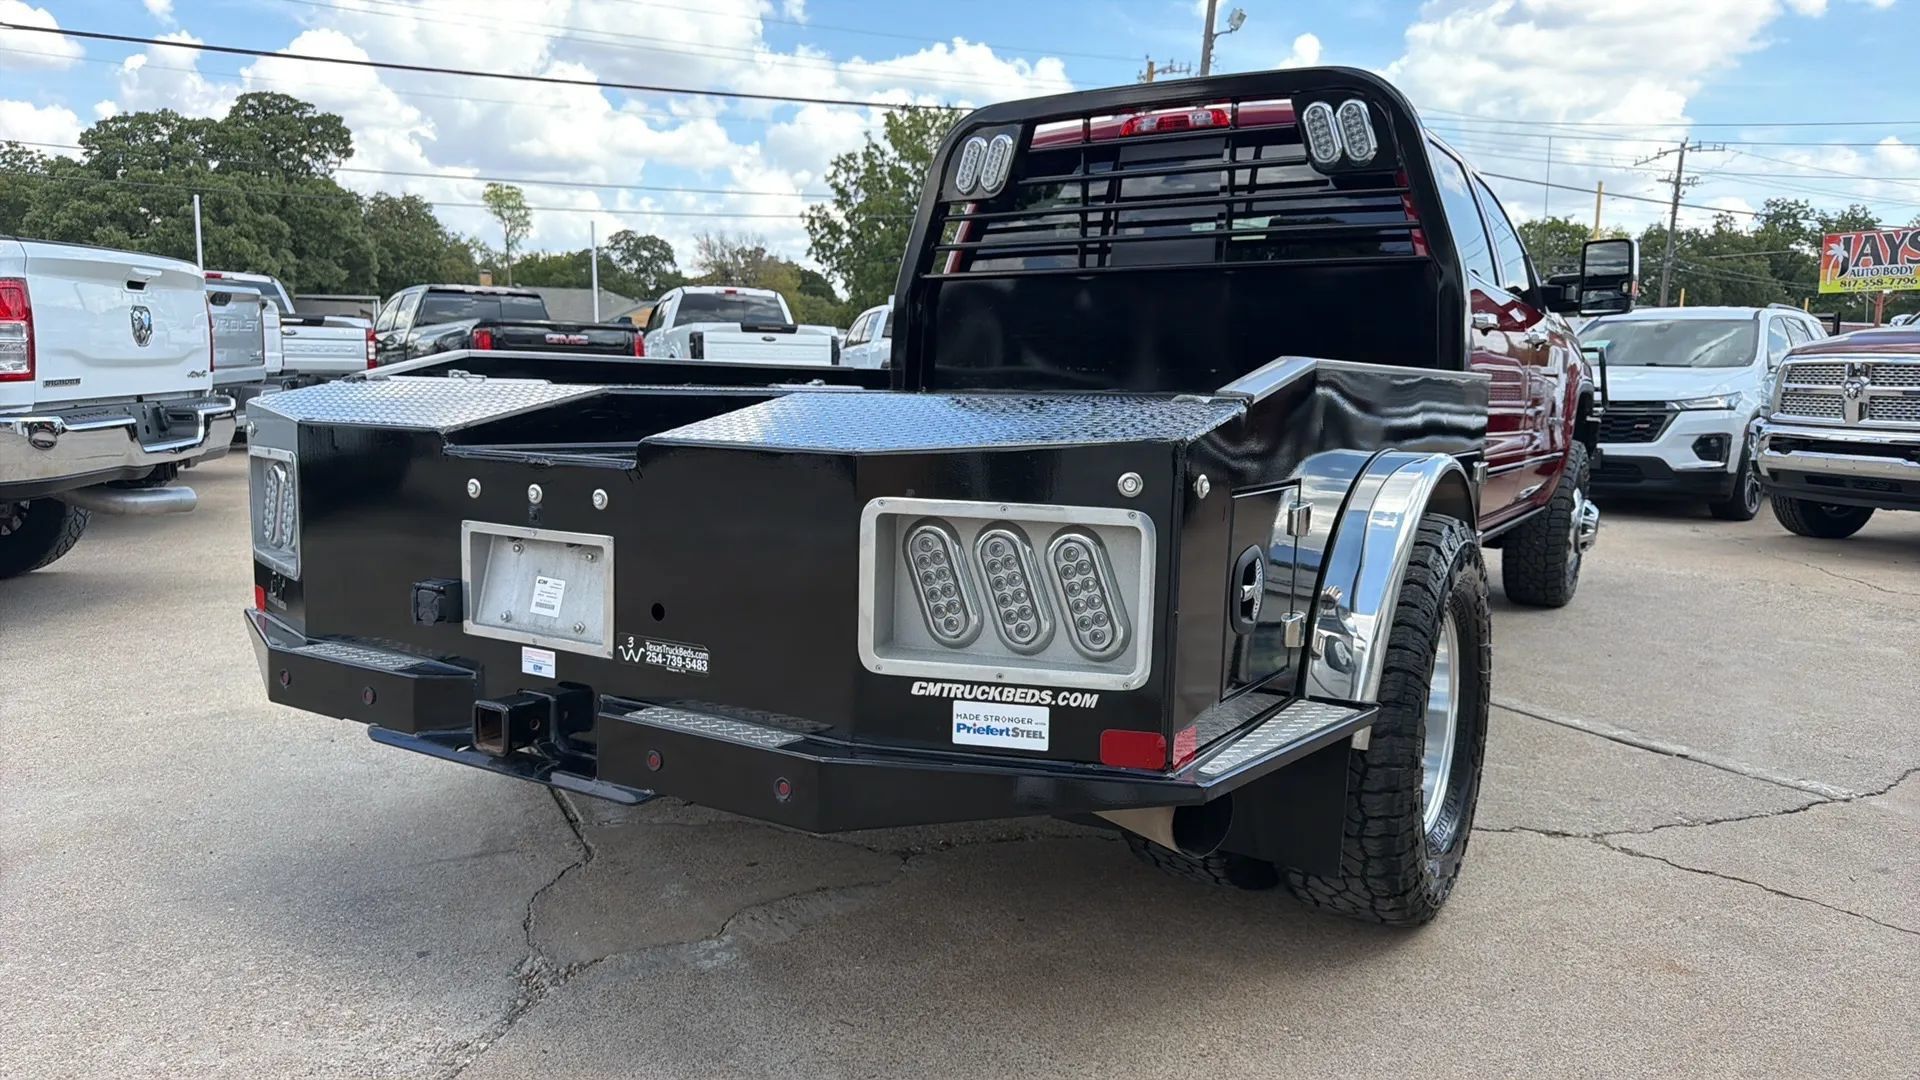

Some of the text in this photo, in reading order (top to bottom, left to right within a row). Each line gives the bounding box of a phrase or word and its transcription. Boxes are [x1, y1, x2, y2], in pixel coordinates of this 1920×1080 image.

[1850, 266, 1915, 277] AUTO BODY
[1840, 278, 1918, 288] 817-558-7796
[545, 334, 589, 345] GMC
[645, 641, 709, 660] TexasTruckBeds.com
[645, 651, 708, 672] 254-739-5483
[910, 681, 1100, 709] CMTRUCKBEDS.COM
[956, 713, 981, 721] MADE
[983, 714, 1033, 726] STRONGER
